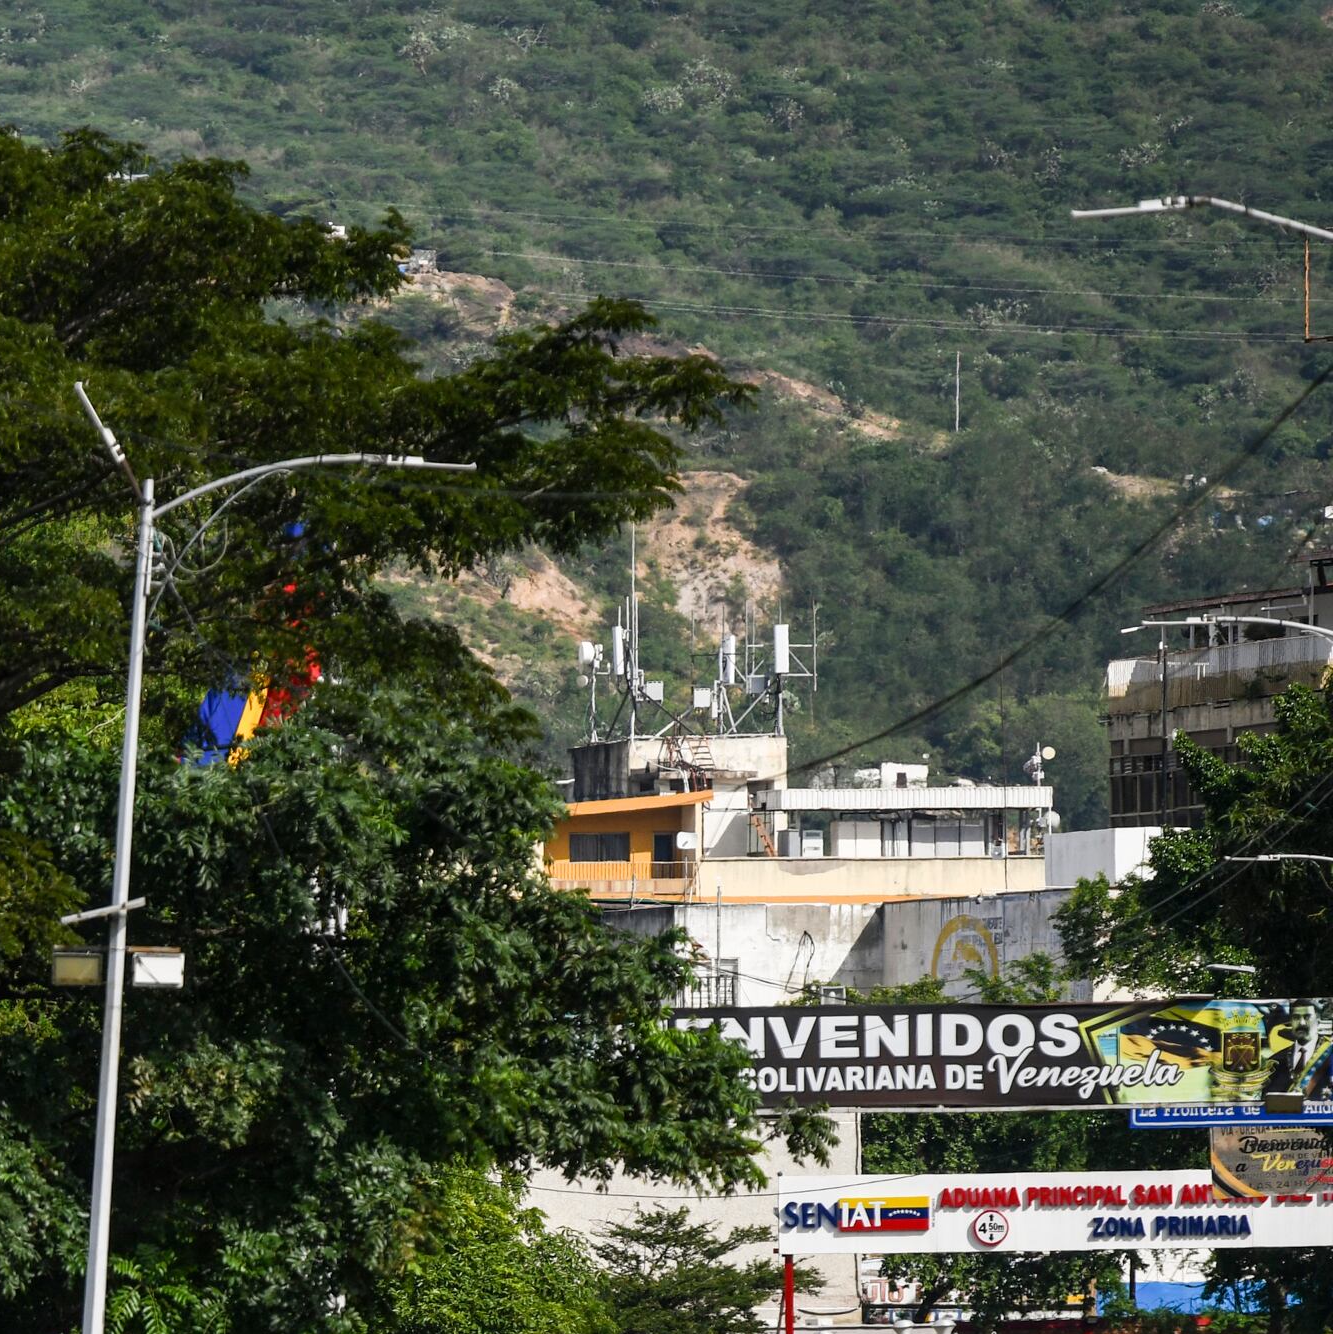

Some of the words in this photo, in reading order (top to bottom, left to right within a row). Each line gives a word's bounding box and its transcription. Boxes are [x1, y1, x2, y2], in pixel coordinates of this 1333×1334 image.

[945, 1064, 984, 1090] DE
[987, 1046, 1183, 1098] Venezuela
[940, 1187, 1021, 1208] ADUANA
[1027, 1185, 1127, 1207] PRINCIPAL
[1134, 1184, 1173, 1206] SAN
[783, 1200, 886, 1229] SENIAT
[1093, 1216, 1145, 1238] ZONA
[1156, 1214, 1252, 1236] PRIMARIA
